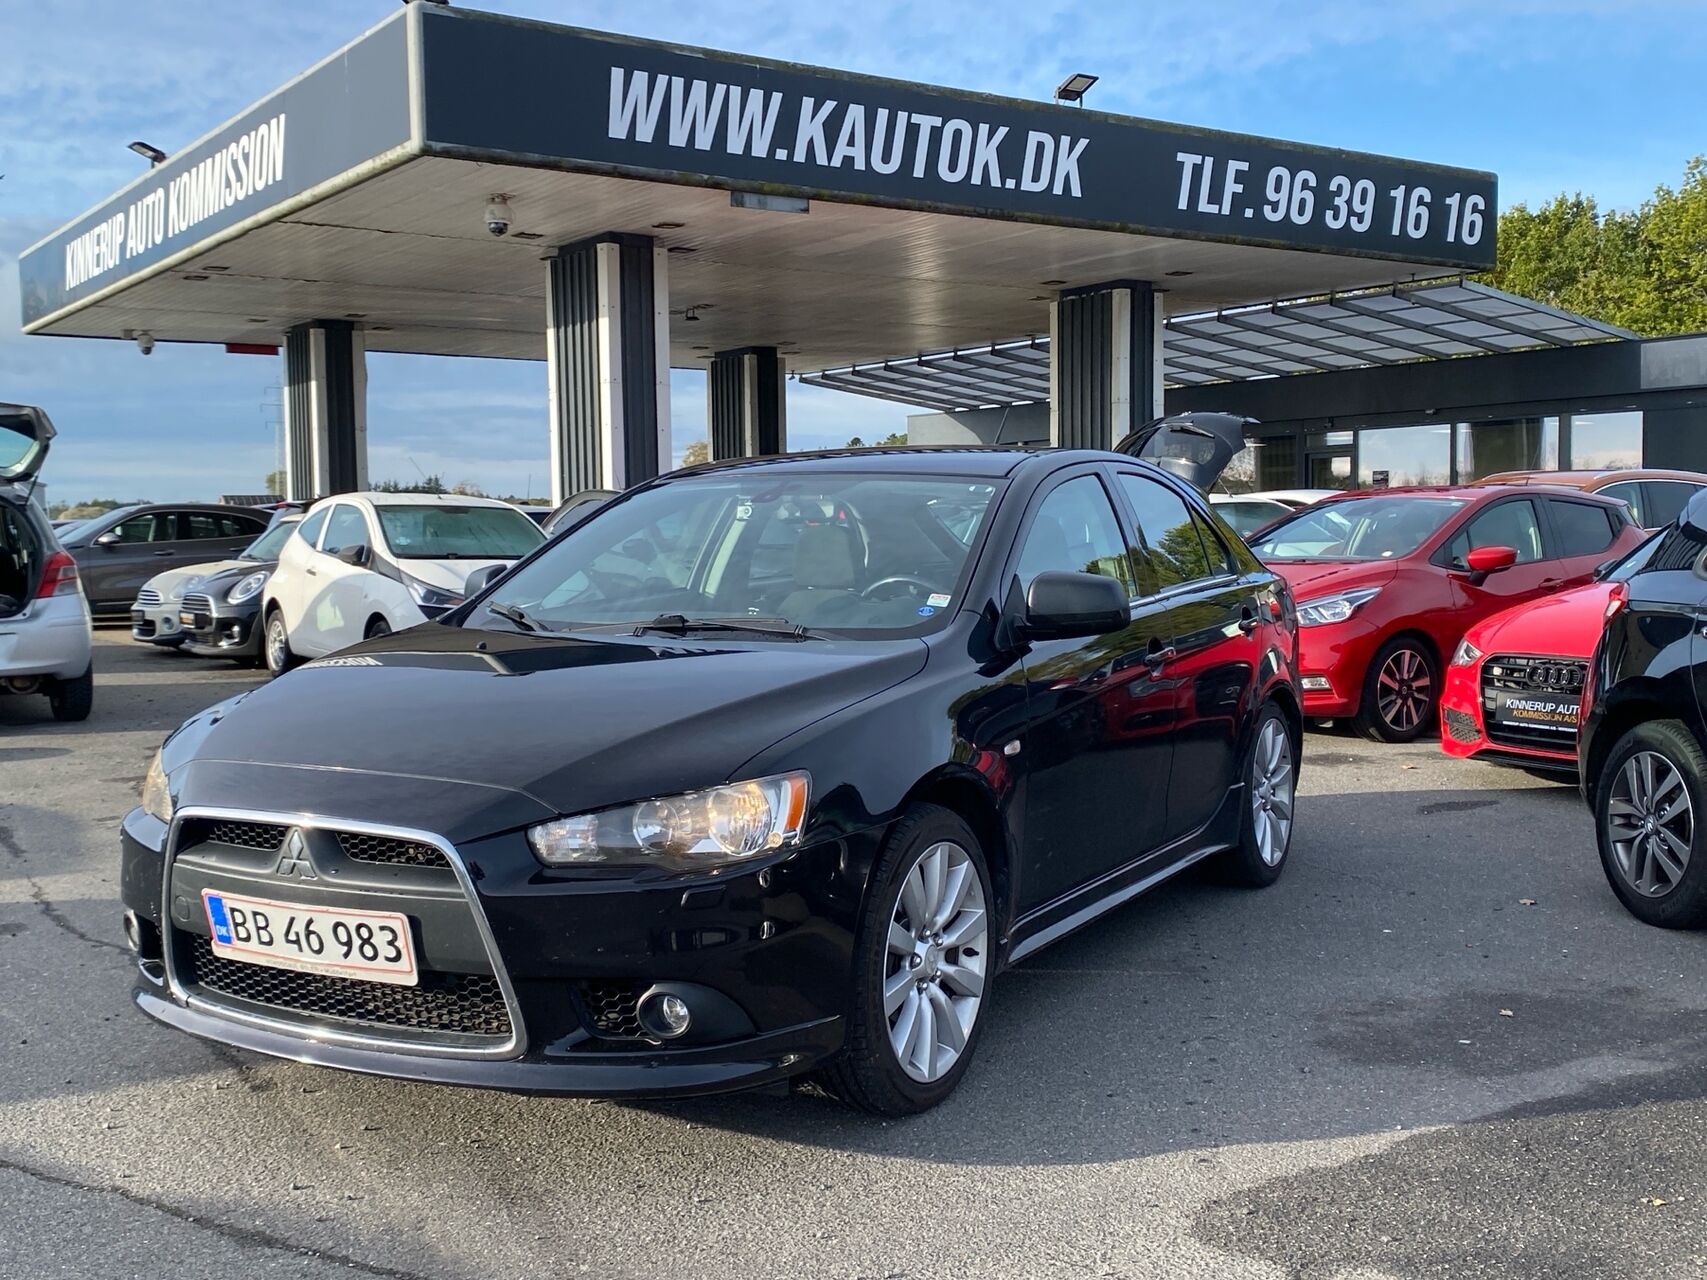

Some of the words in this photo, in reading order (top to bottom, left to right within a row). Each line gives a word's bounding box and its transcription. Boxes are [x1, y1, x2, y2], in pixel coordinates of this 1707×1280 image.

[608, 66, 1089, 198] WWW.KAUTOK.DK
[65, 212, 125, 291] KINNERUP
[126, 187, 165, 259] AUTO
[167, 113, 286, 238] KOMMISSION
[1176, 152, 1254, 218] TLF.
[1263, 166, 1317, 225] 96
[1325, 175, 1376, 233] 39
[1390, 184, 1432, 240] 16
[1445, 192, 1486, 245] 16
[1506, 698, 1556, 713] KINNERUP
[1512, 709, 1563, 721] KOMMISSION
[215, 925, 229, 937] DK
[228, 907, 274, 947] BB
[284, 916, 324, 955] 46
[332, 920, 402, 962] 983
